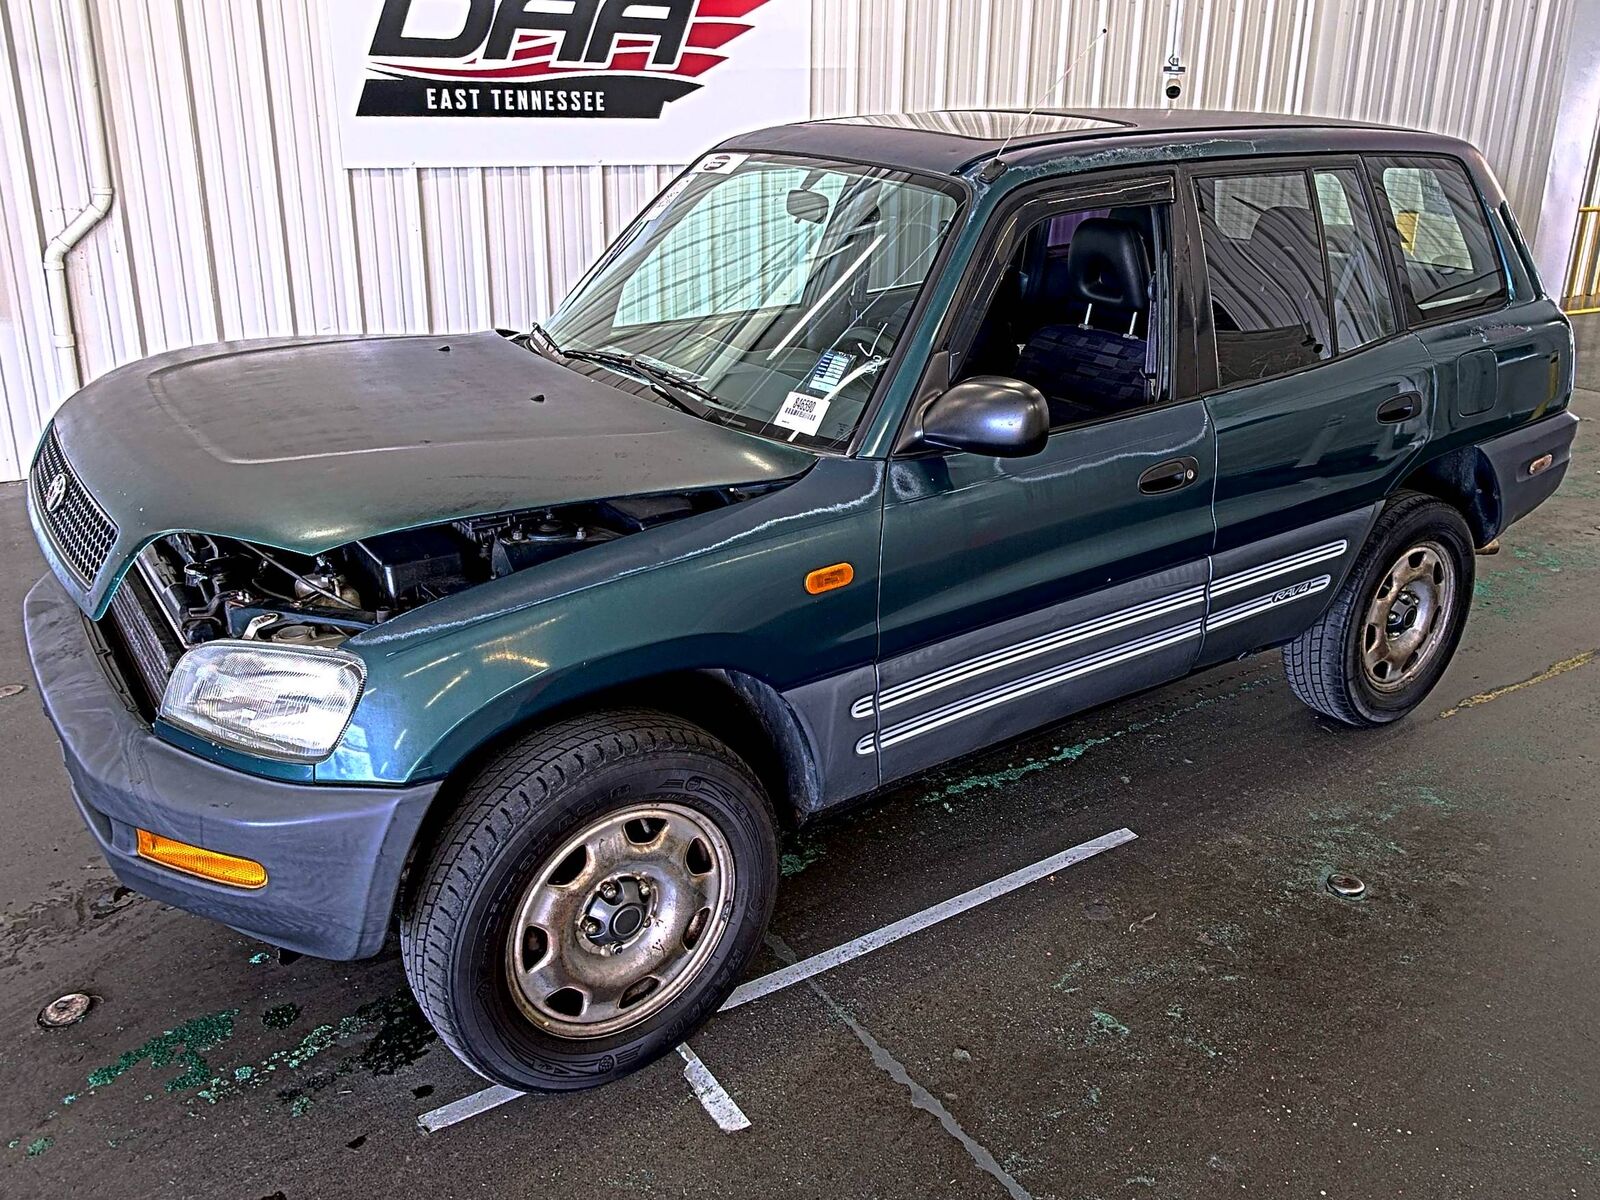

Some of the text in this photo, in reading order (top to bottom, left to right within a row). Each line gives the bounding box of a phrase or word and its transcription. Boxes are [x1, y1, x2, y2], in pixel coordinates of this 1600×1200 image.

[368, 0, 699, 65] DAA
[426, 87, 605, 111] EAST TENNESSEE
[1273, 582, 1309, 602] RAV4
